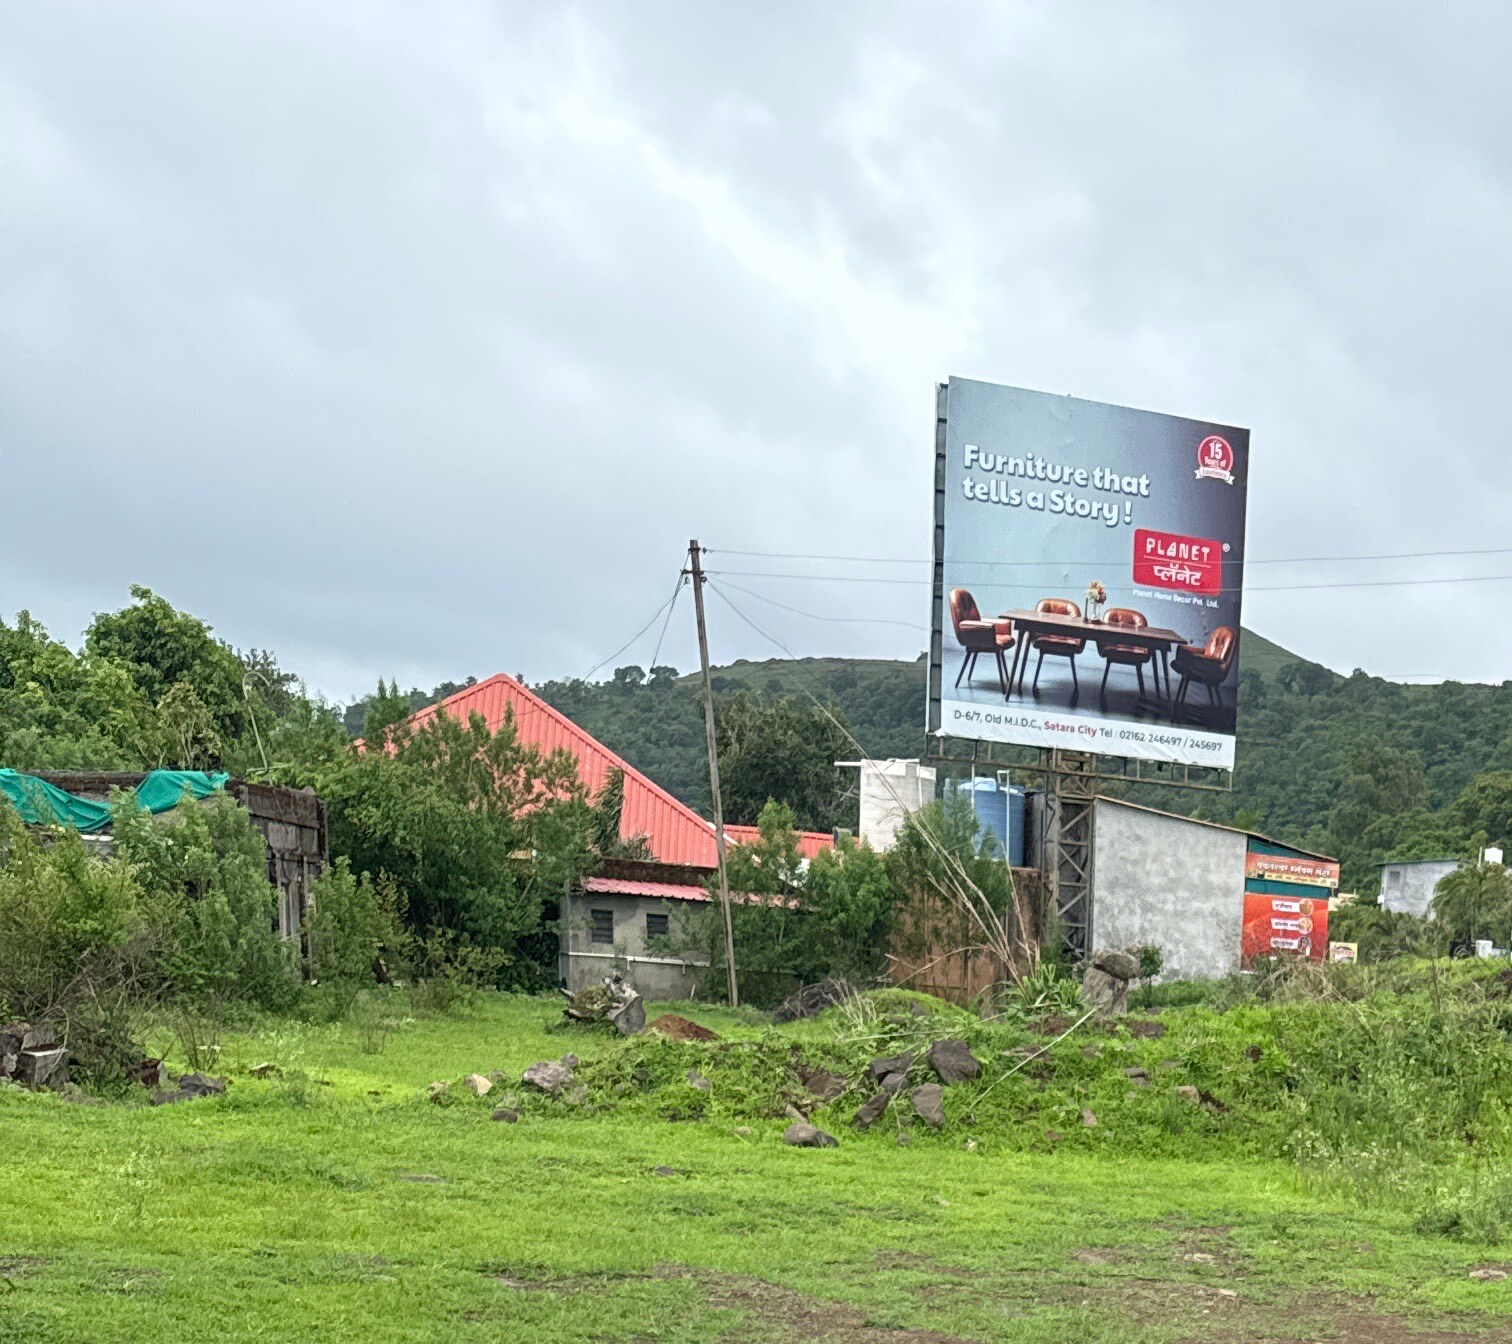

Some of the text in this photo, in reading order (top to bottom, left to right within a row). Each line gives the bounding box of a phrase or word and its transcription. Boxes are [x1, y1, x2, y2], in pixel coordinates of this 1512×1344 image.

[1209, 442, 1223, 460] 15
[963, 444, 1151, 497] Furniture that
[962, 476, 1022, 507] tells
[1026, 491, 1045, 511] a
[1049, 489, 1120, 528] Story
[1146, 538, 1211, 563] PLANET
[984, 713, 1002, 724] Old
[1044, 721, 1075, 733] Satara
[1077, 725, 1098, 738] City
